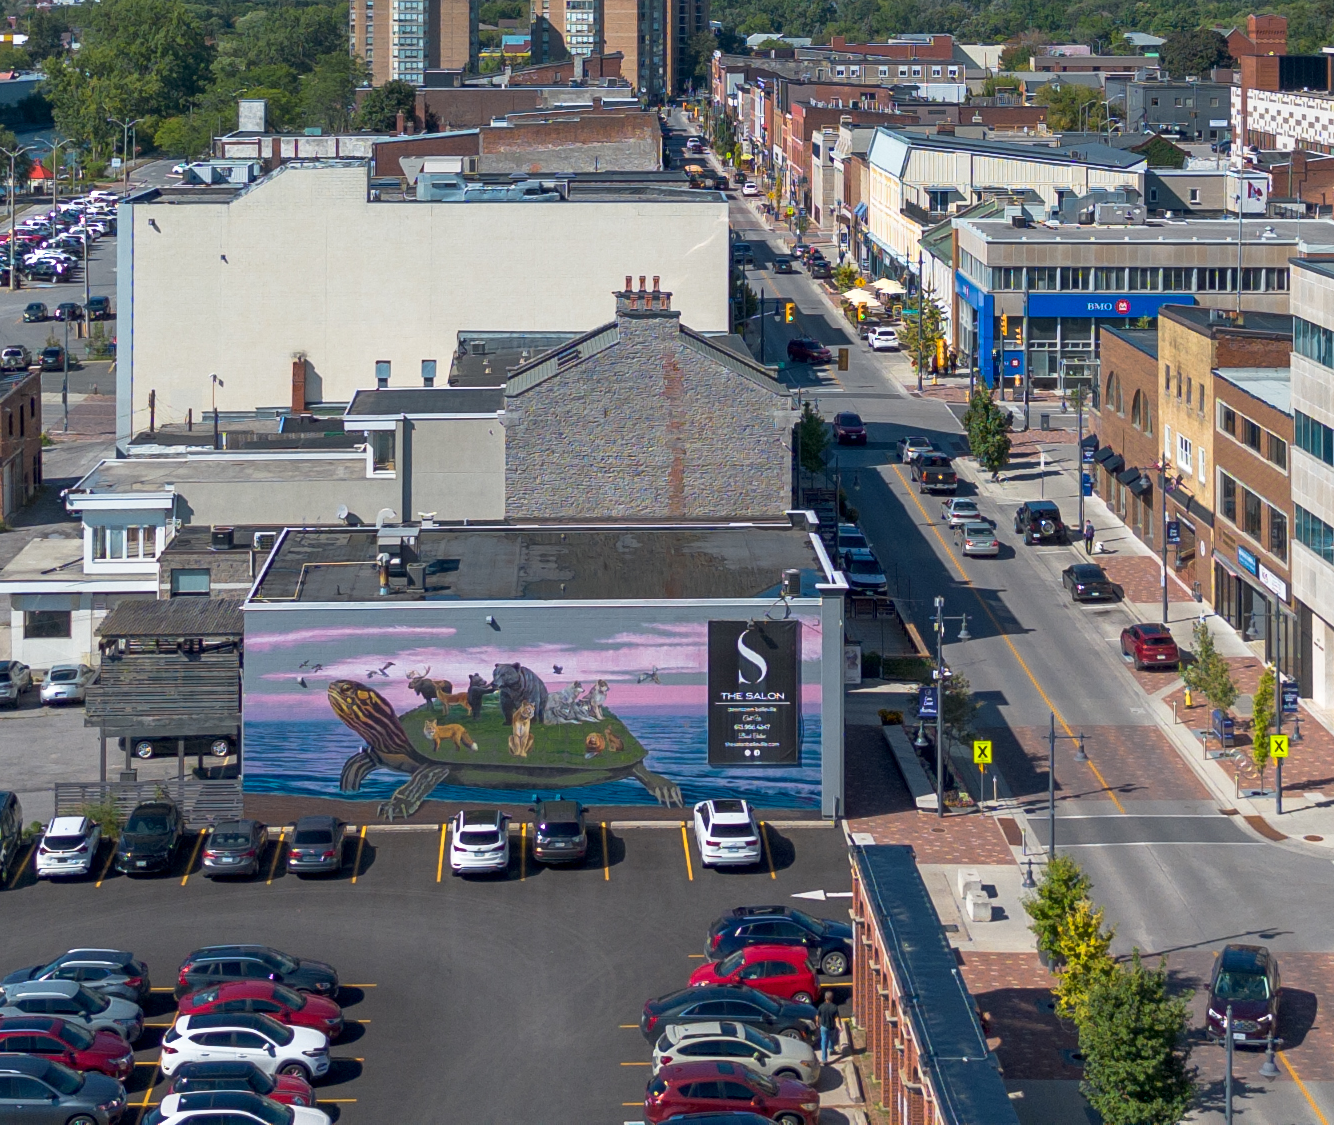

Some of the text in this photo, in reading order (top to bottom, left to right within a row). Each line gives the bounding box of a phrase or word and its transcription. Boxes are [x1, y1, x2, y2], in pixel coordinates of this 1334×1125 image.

[1087, 302, 1113, 311] BMO
[721, 692, 785, 700] THE SALON
[977, 745, 988, 759] X
[1274, 740, 1284, 753] X
